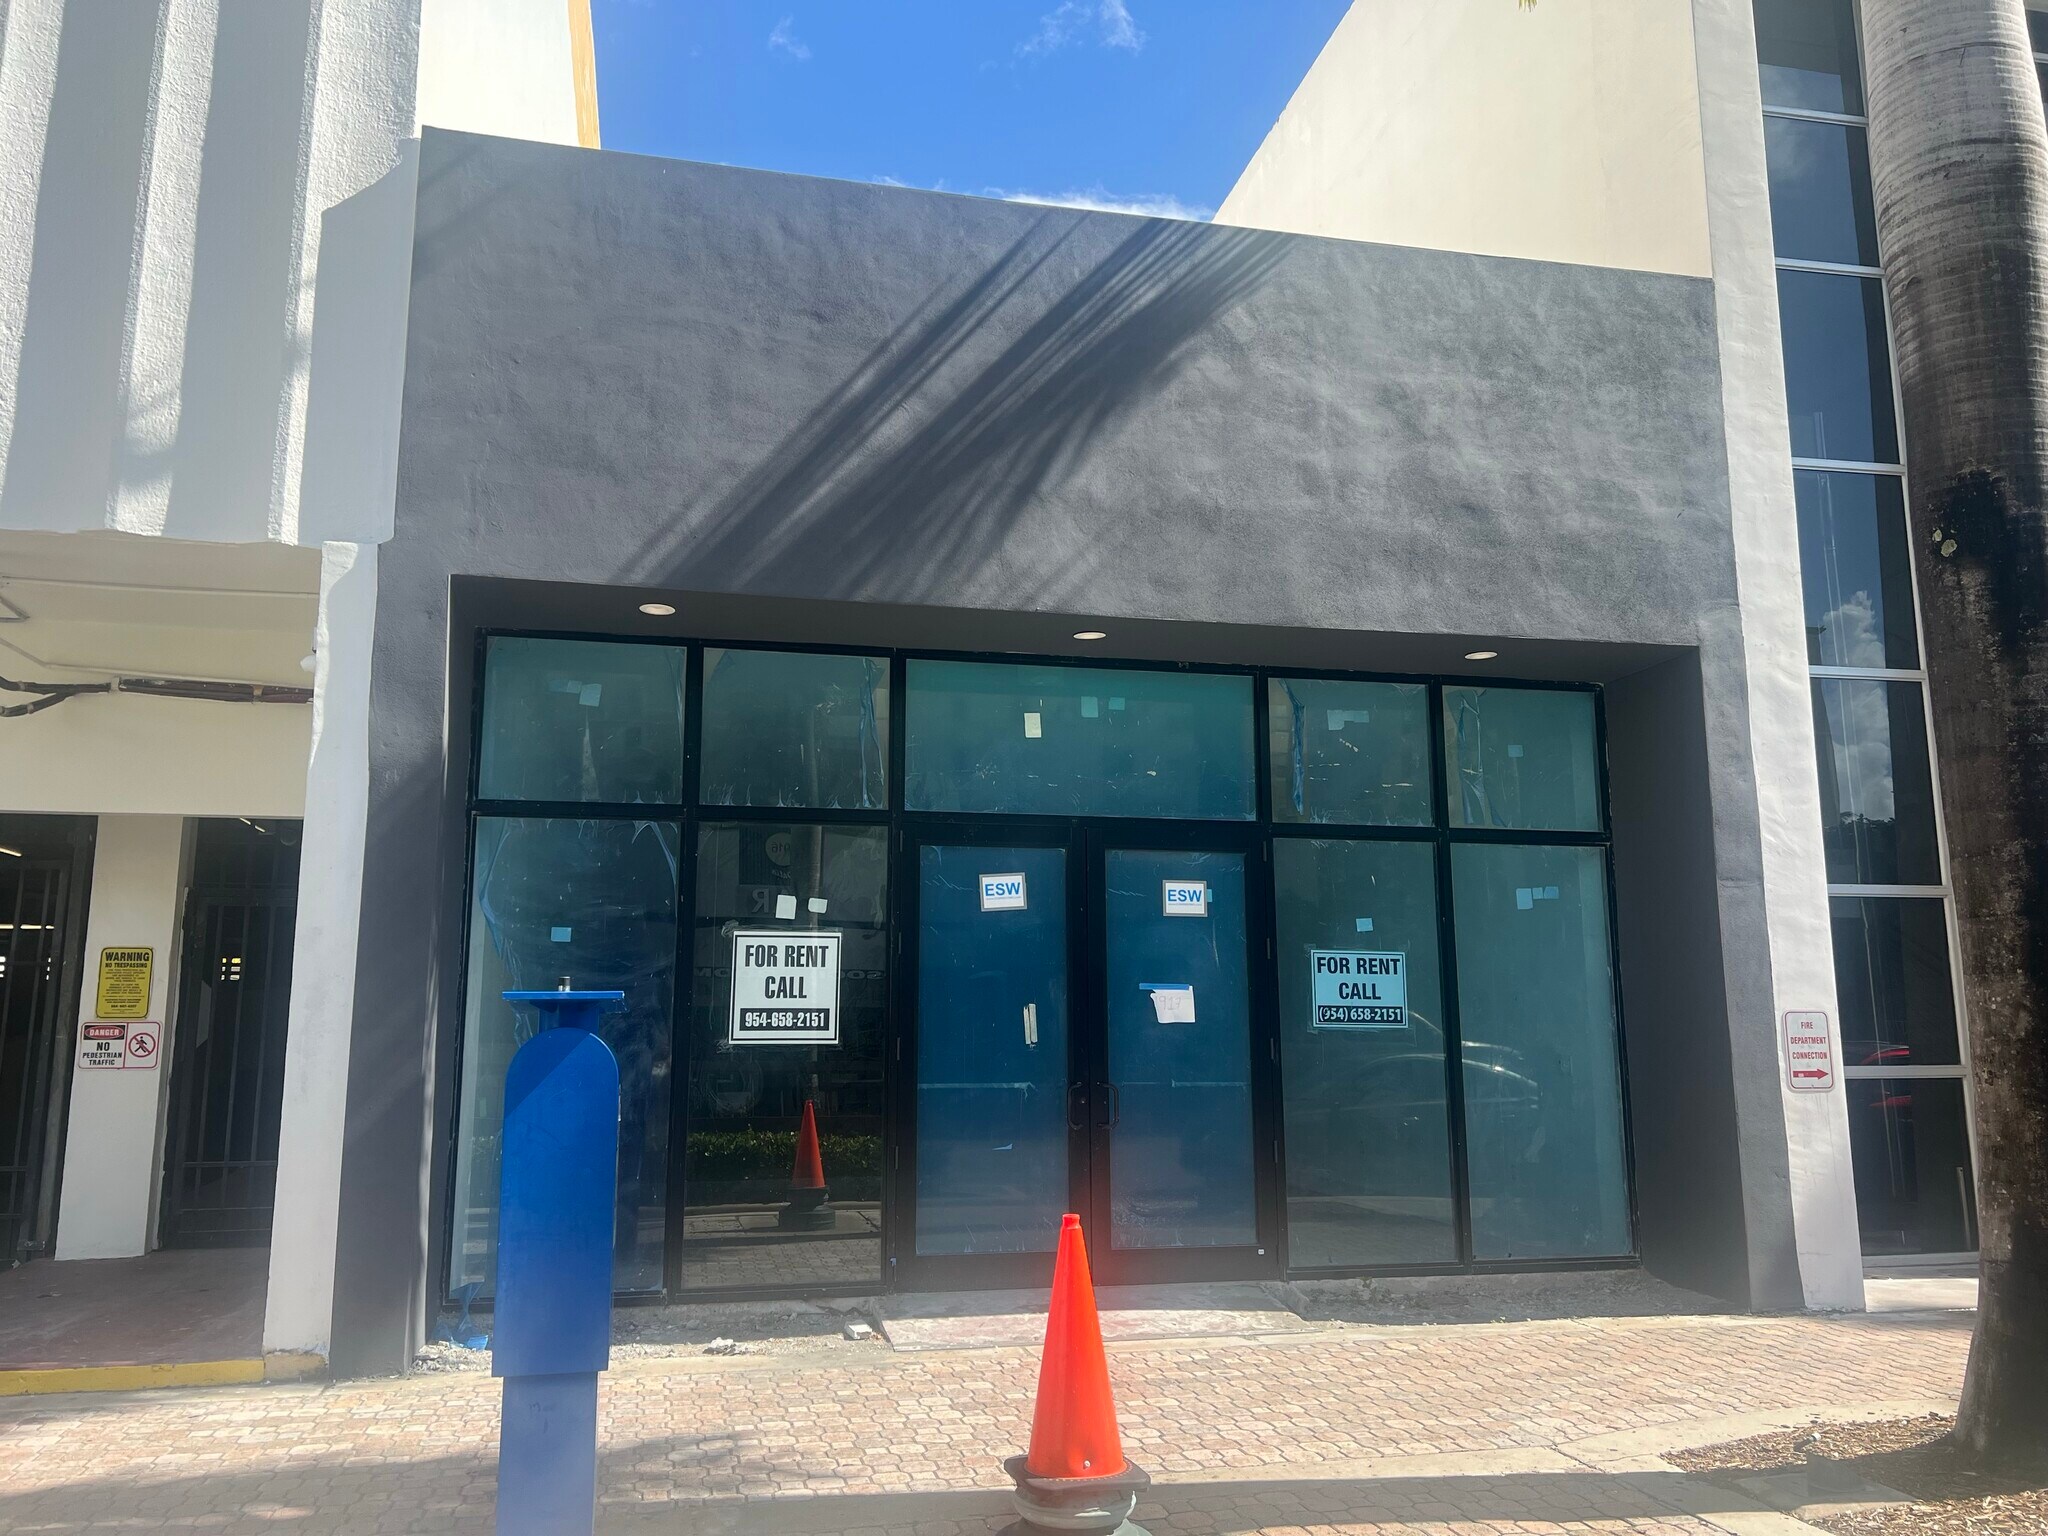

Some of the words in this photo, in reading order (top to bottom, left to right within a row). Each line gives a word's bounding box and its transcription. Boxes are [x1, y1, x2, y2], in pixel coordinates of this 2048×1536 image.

[985, 882, 1021, 896] ESW
[1167, 889, 1202, 902] ESW
[105, 952, 149, 961] WARNING
[745, 944, 778, 967] FOR
[784, 945, 829, 967] RENT
[1317, 957, 1350, 974] FOR
[1356, 958, 1400, 975] RENT
[764, 976, 807, 999] CALL
[1339, 982, 1381, 1000] CALL
[745, 1012, 825, 1027] 954-658-2151
[1319, 1007, 1348, 1021] (954)
[1350, 1008, 1401, 1020] 658-2151
[96, 1042, 110, 1051] NO
